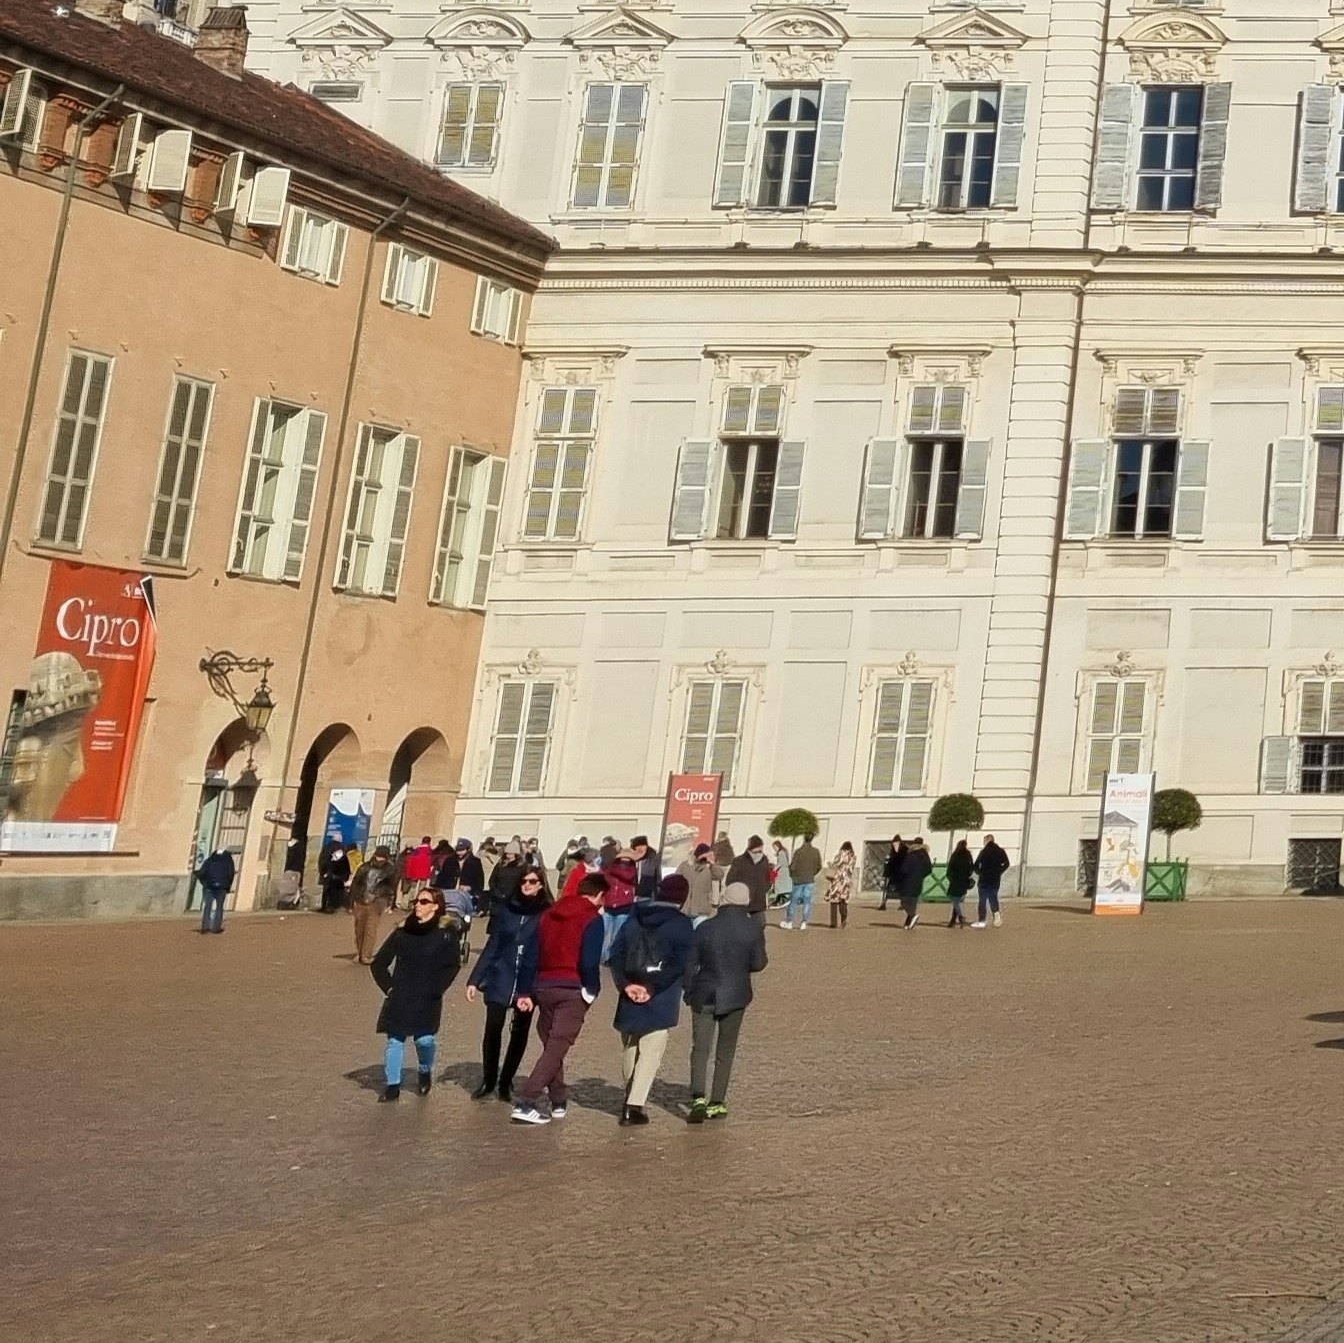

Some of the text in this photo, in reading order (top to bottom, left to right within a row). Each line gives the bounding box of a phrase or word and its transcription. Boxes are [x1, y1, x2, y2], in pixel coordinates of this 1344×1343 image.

[56, 597, 140, 656] Cipro
[674, 788, 714, 804] Cipro
[1110, 789, 1148, 798] Animali
